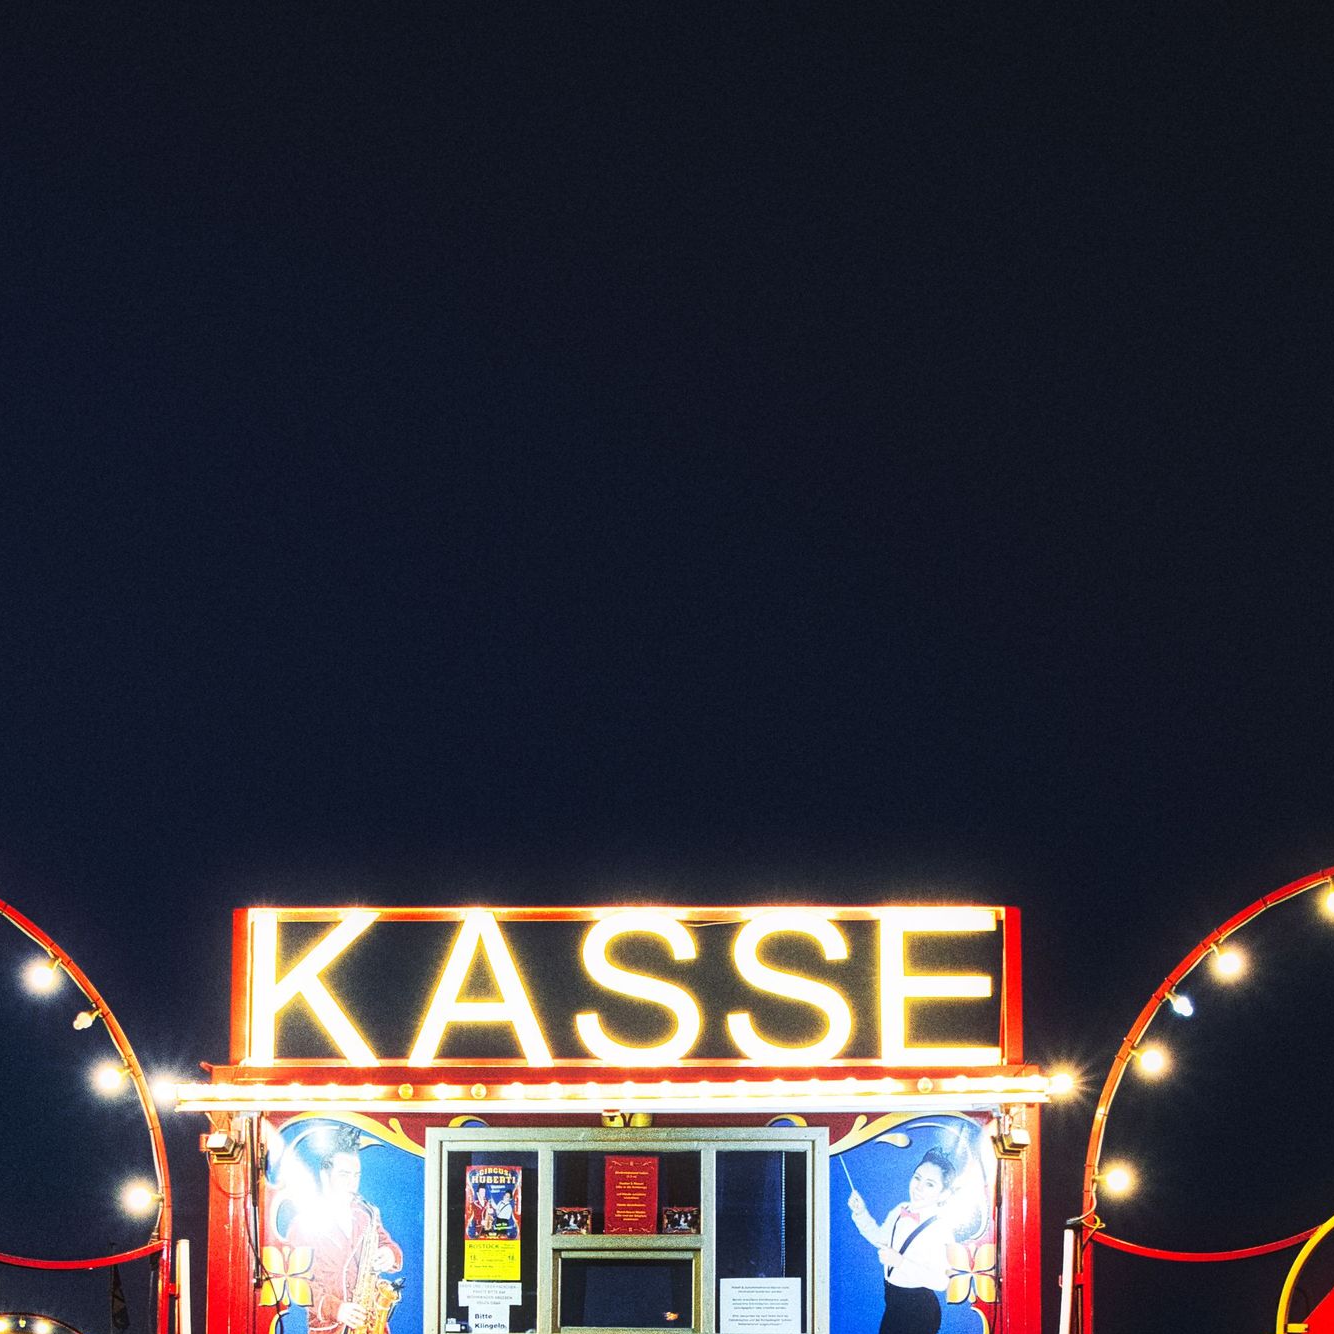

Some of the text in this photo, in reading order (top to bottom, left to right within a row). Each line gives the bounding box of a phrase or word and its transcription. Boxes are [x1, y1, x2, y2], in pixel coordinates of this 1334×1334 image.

[248, 908, 1002, 1068] KASSE
[479, 1167, 509, 1176] CIRCUS
[471, 1175, 516, 1184] HUBERTI
